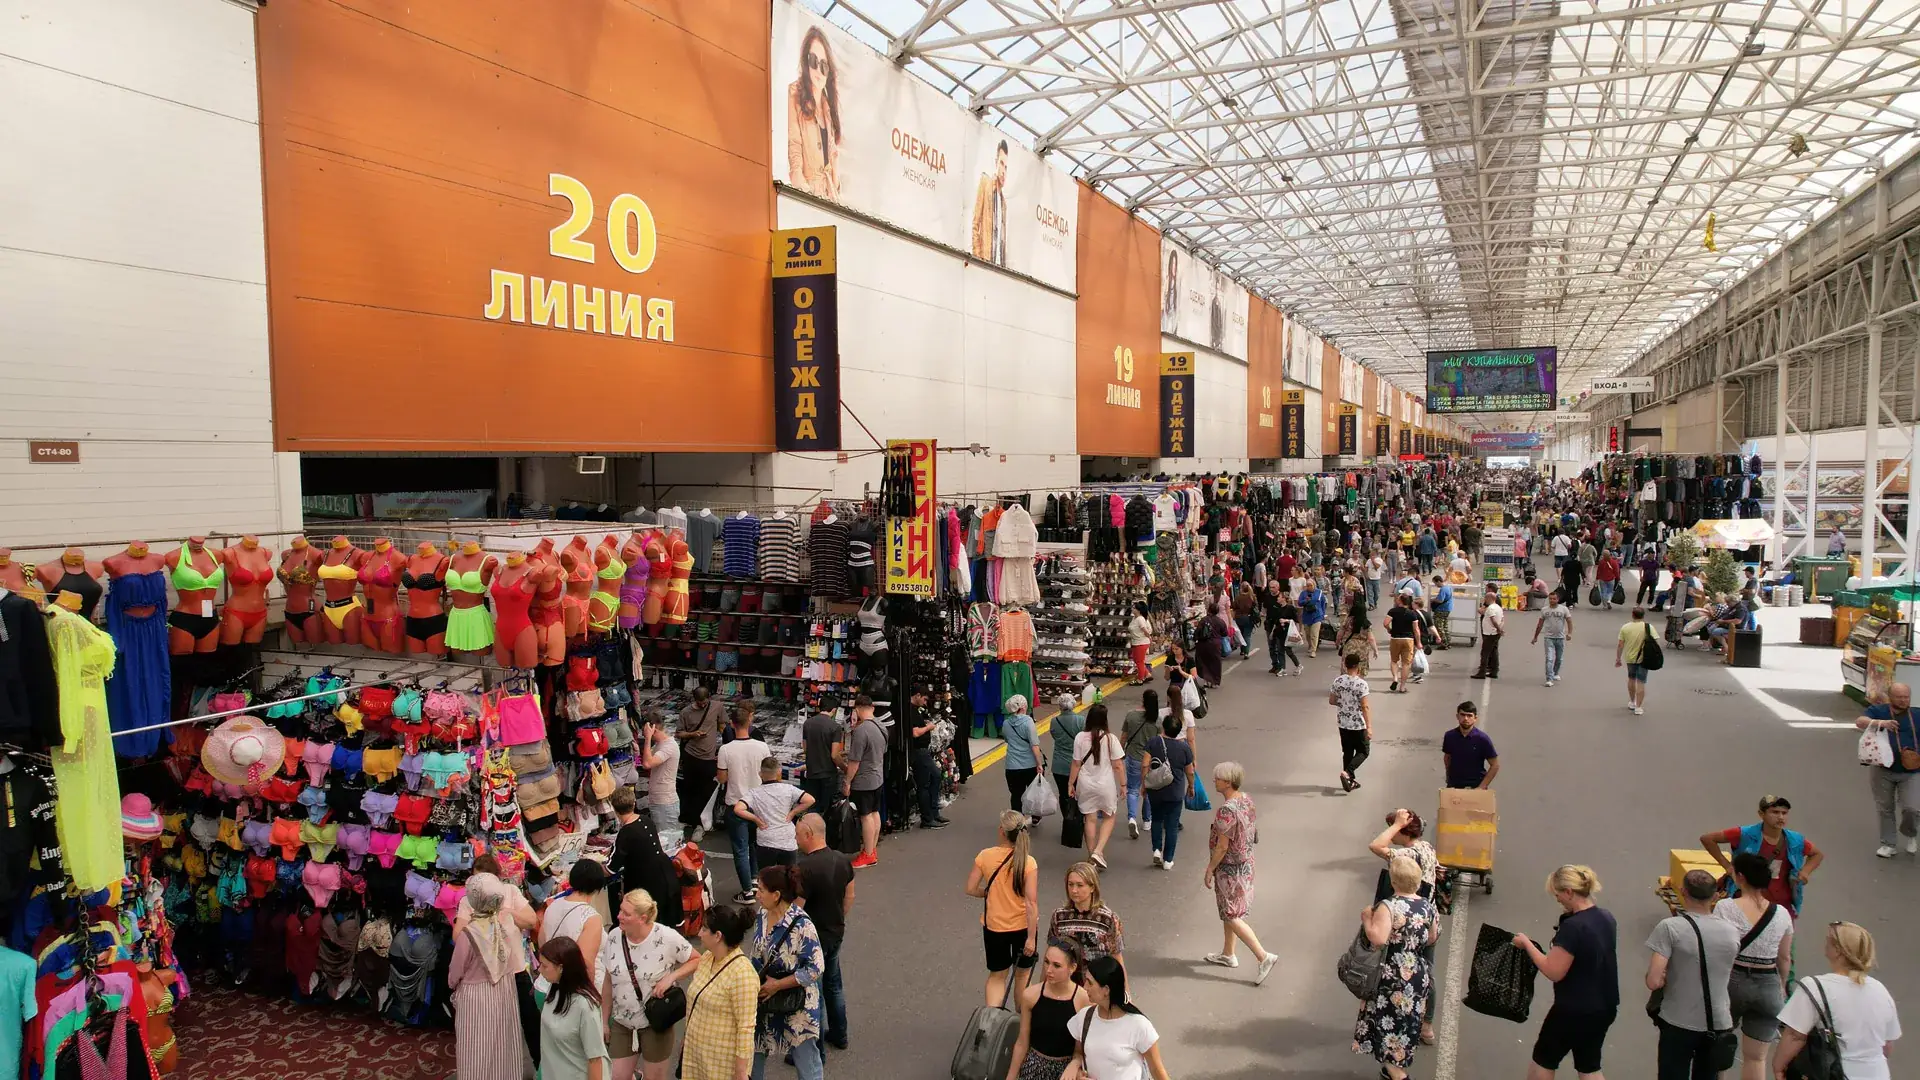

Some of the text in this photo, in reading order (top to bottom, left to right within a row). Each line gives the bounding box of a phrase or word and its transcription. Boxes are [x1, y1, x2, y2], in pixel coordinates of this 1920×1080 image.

[891, 127, 946, 174] ОДЕЖДА
[902, 165, 936, 191] ЖЕНСКАЯ
[549, 173, 656, 273] 20
[1036, 204, 1069, 236] ОДЕЖДА
[787, 236, 821, 258] 20
[785, 259, 822, 269] ЛИНИЯ
[484, 268, 674, 342] ЛИНИЯ
[790, 287, 820, 440] ОДЕЖДА
[1114, 345, 1133, 383] 19
[1169, 356, 1187, 366] 19
[1444, 353, 1535, 367] МИР КУПАЛЬНИКОВ
[1106, 383, 1140, 408] ЛИНИЯ
[1263, 386, 1271, 408] 18
[1168, 380, 1185, 452] ОДЕЖДА
[1287, 408, 1298, 455] ОДЕЖДА
[38, 448, 72, 456] СТ4-80
[896, 583, 909, 591] 915
